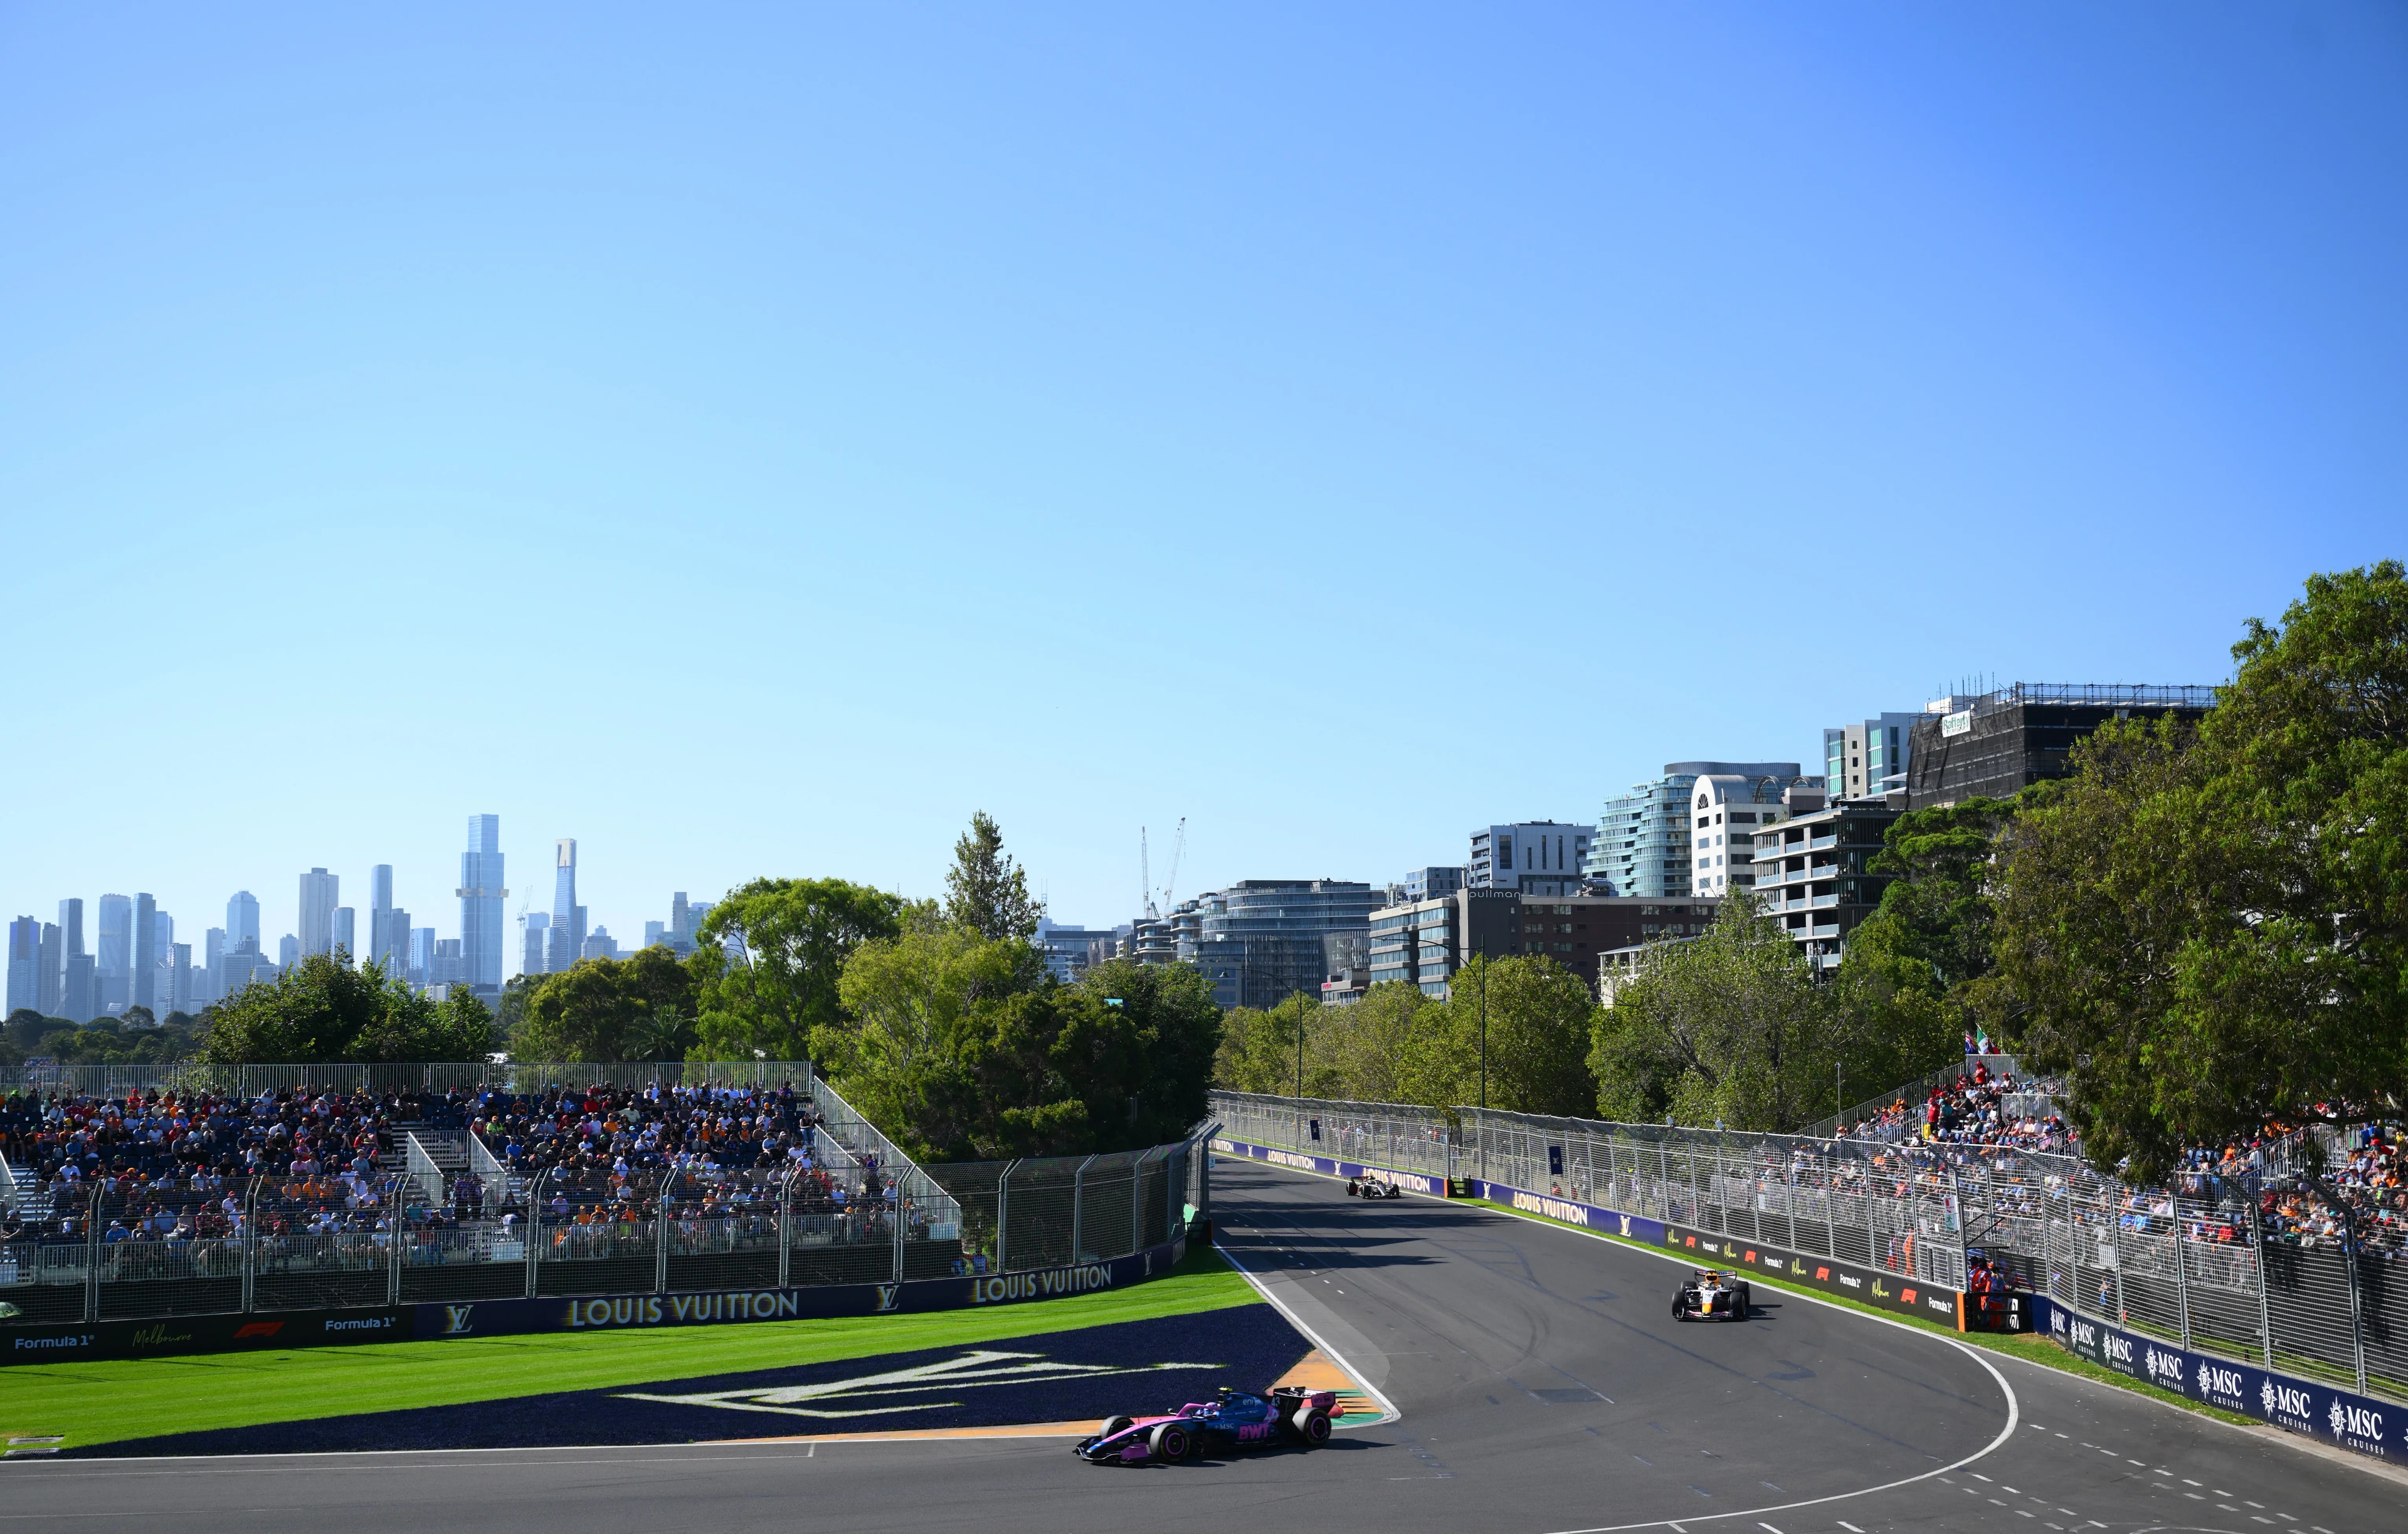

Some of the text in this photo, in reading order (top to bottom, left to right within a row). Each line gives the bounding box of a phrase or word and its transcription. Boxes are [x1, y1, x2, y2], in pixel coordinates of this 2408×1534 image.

[1469, 890, 1521, 901] pullman
[1213, 1139, 1234, 1153] VUITTON
[1267, 1150, 1316, 1170] LOUIS VUITTON
[1390, 1172, 1430, 1193] VUITTON
[1514, 1191, 1588, 1226] LOUIS VUITTON
[1765, 1256, 1779, 1268] Formula
[976, 1264, 1111, 1303] LOUIS VUITTON
[1840, 1274, 1857, 1287] Formula
[572, 1291, 798, 1326] LOUIS VUITTON
[1928, 1296, 1948, 1313] Formula
[325, 1318, 381, 1330] Formula
[2054, 1310, 2066, 1333] MSC
[15, 1336, 77, 1349] Formula
[132, 1323, 193, 1348] Melbourne
[2056, 1333, 2066, 1343] CRUISES
[2078, 1321, 2095, 1347] MSC
[2078, 1345, 2096, 1358] CRUISES
[2111, 1335, 2133, 1363] MSC
[2112, 1360, 2133, 1374] CRUISES
[2157, 1351, 2183, 1380] MSC
[2159, 1378, 2184, 1393] CRUISES
[2212, 1367, 2242, 1397] MSC
[1242, 1397, 1254, 1405] eni
[1271, 1396, 1280, 1407] 43
[2214, 1395, 2243, 1410] CRUISES
[2277, 1385, 2311, 1419] MSC
[1238, 1422, 1269, 1440] BWT
[2278, 1414, 2311, 1432] CRUISES
[2346, 1405, 2383, 1441] MSC
[2348, 1437, 2384, 1456] CRUISES
